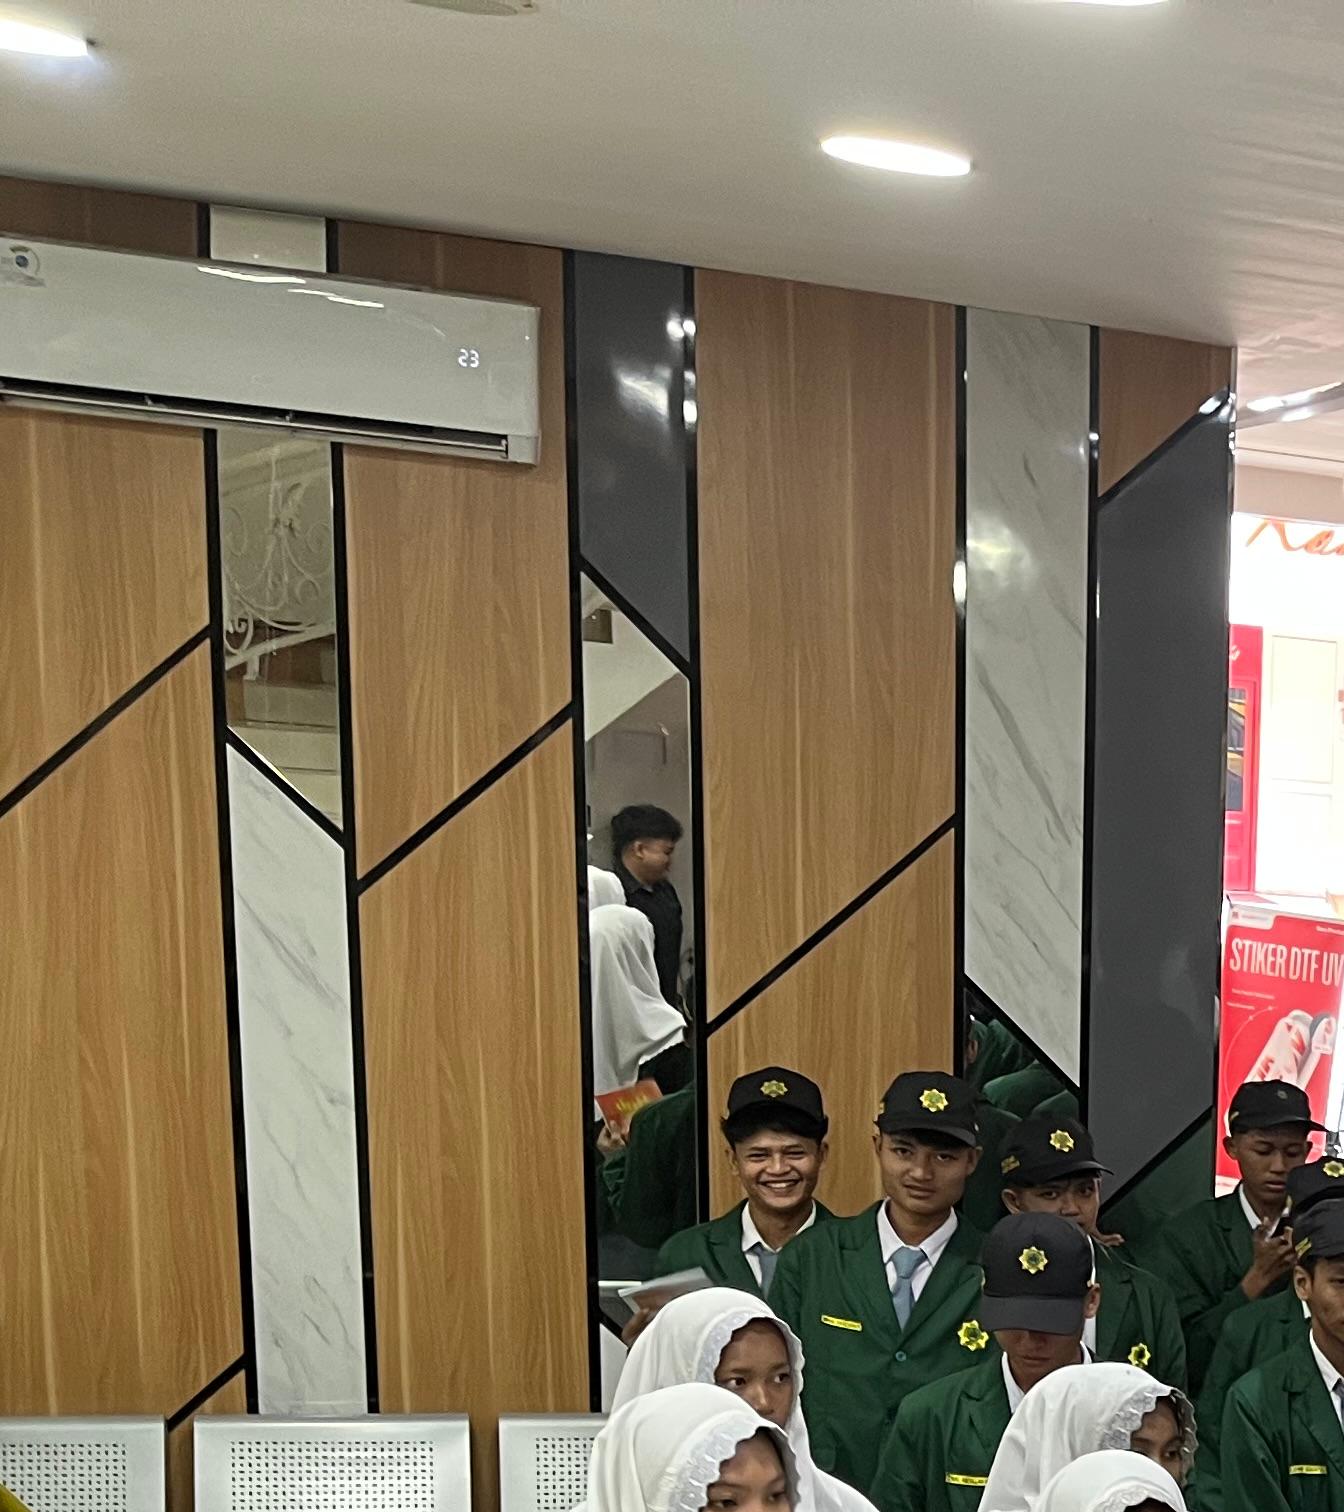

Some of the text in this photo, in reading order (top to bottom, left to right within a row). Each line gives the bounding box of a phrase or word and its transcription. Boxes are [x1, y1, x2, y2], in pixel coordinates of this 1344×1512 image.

[458, 348, 480, 368] 23
[1229, 937, 1288, 980] STIKER
[1289, 946, 1320, 984] DTF
